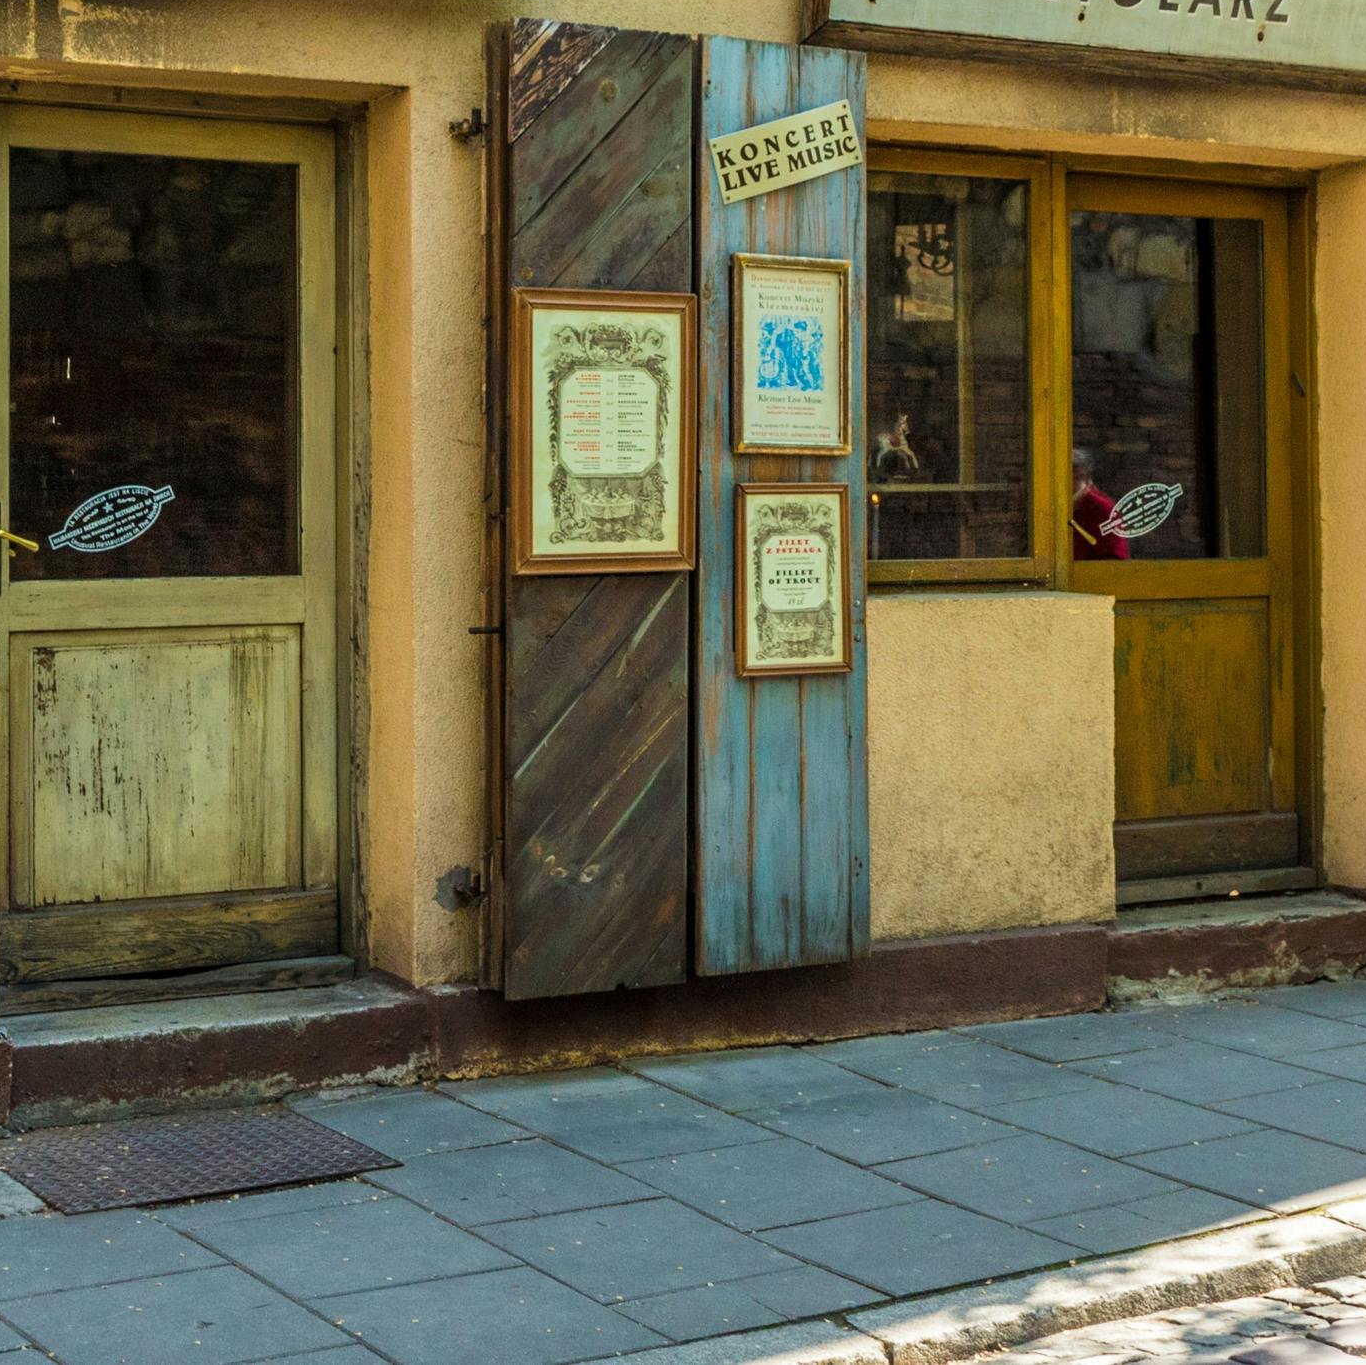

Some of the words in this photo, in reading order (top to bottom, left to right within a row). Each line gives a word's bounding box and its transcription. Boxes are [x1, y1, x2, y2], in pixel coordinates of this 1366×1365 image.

[716, 114, 849, 169] KONCERT
[721, 158, 781, 191] LIVE
[787, 136, 857, 172] MUSIC
[100, 532, 115, 540] The
[116, 523, 135, 534] Most
